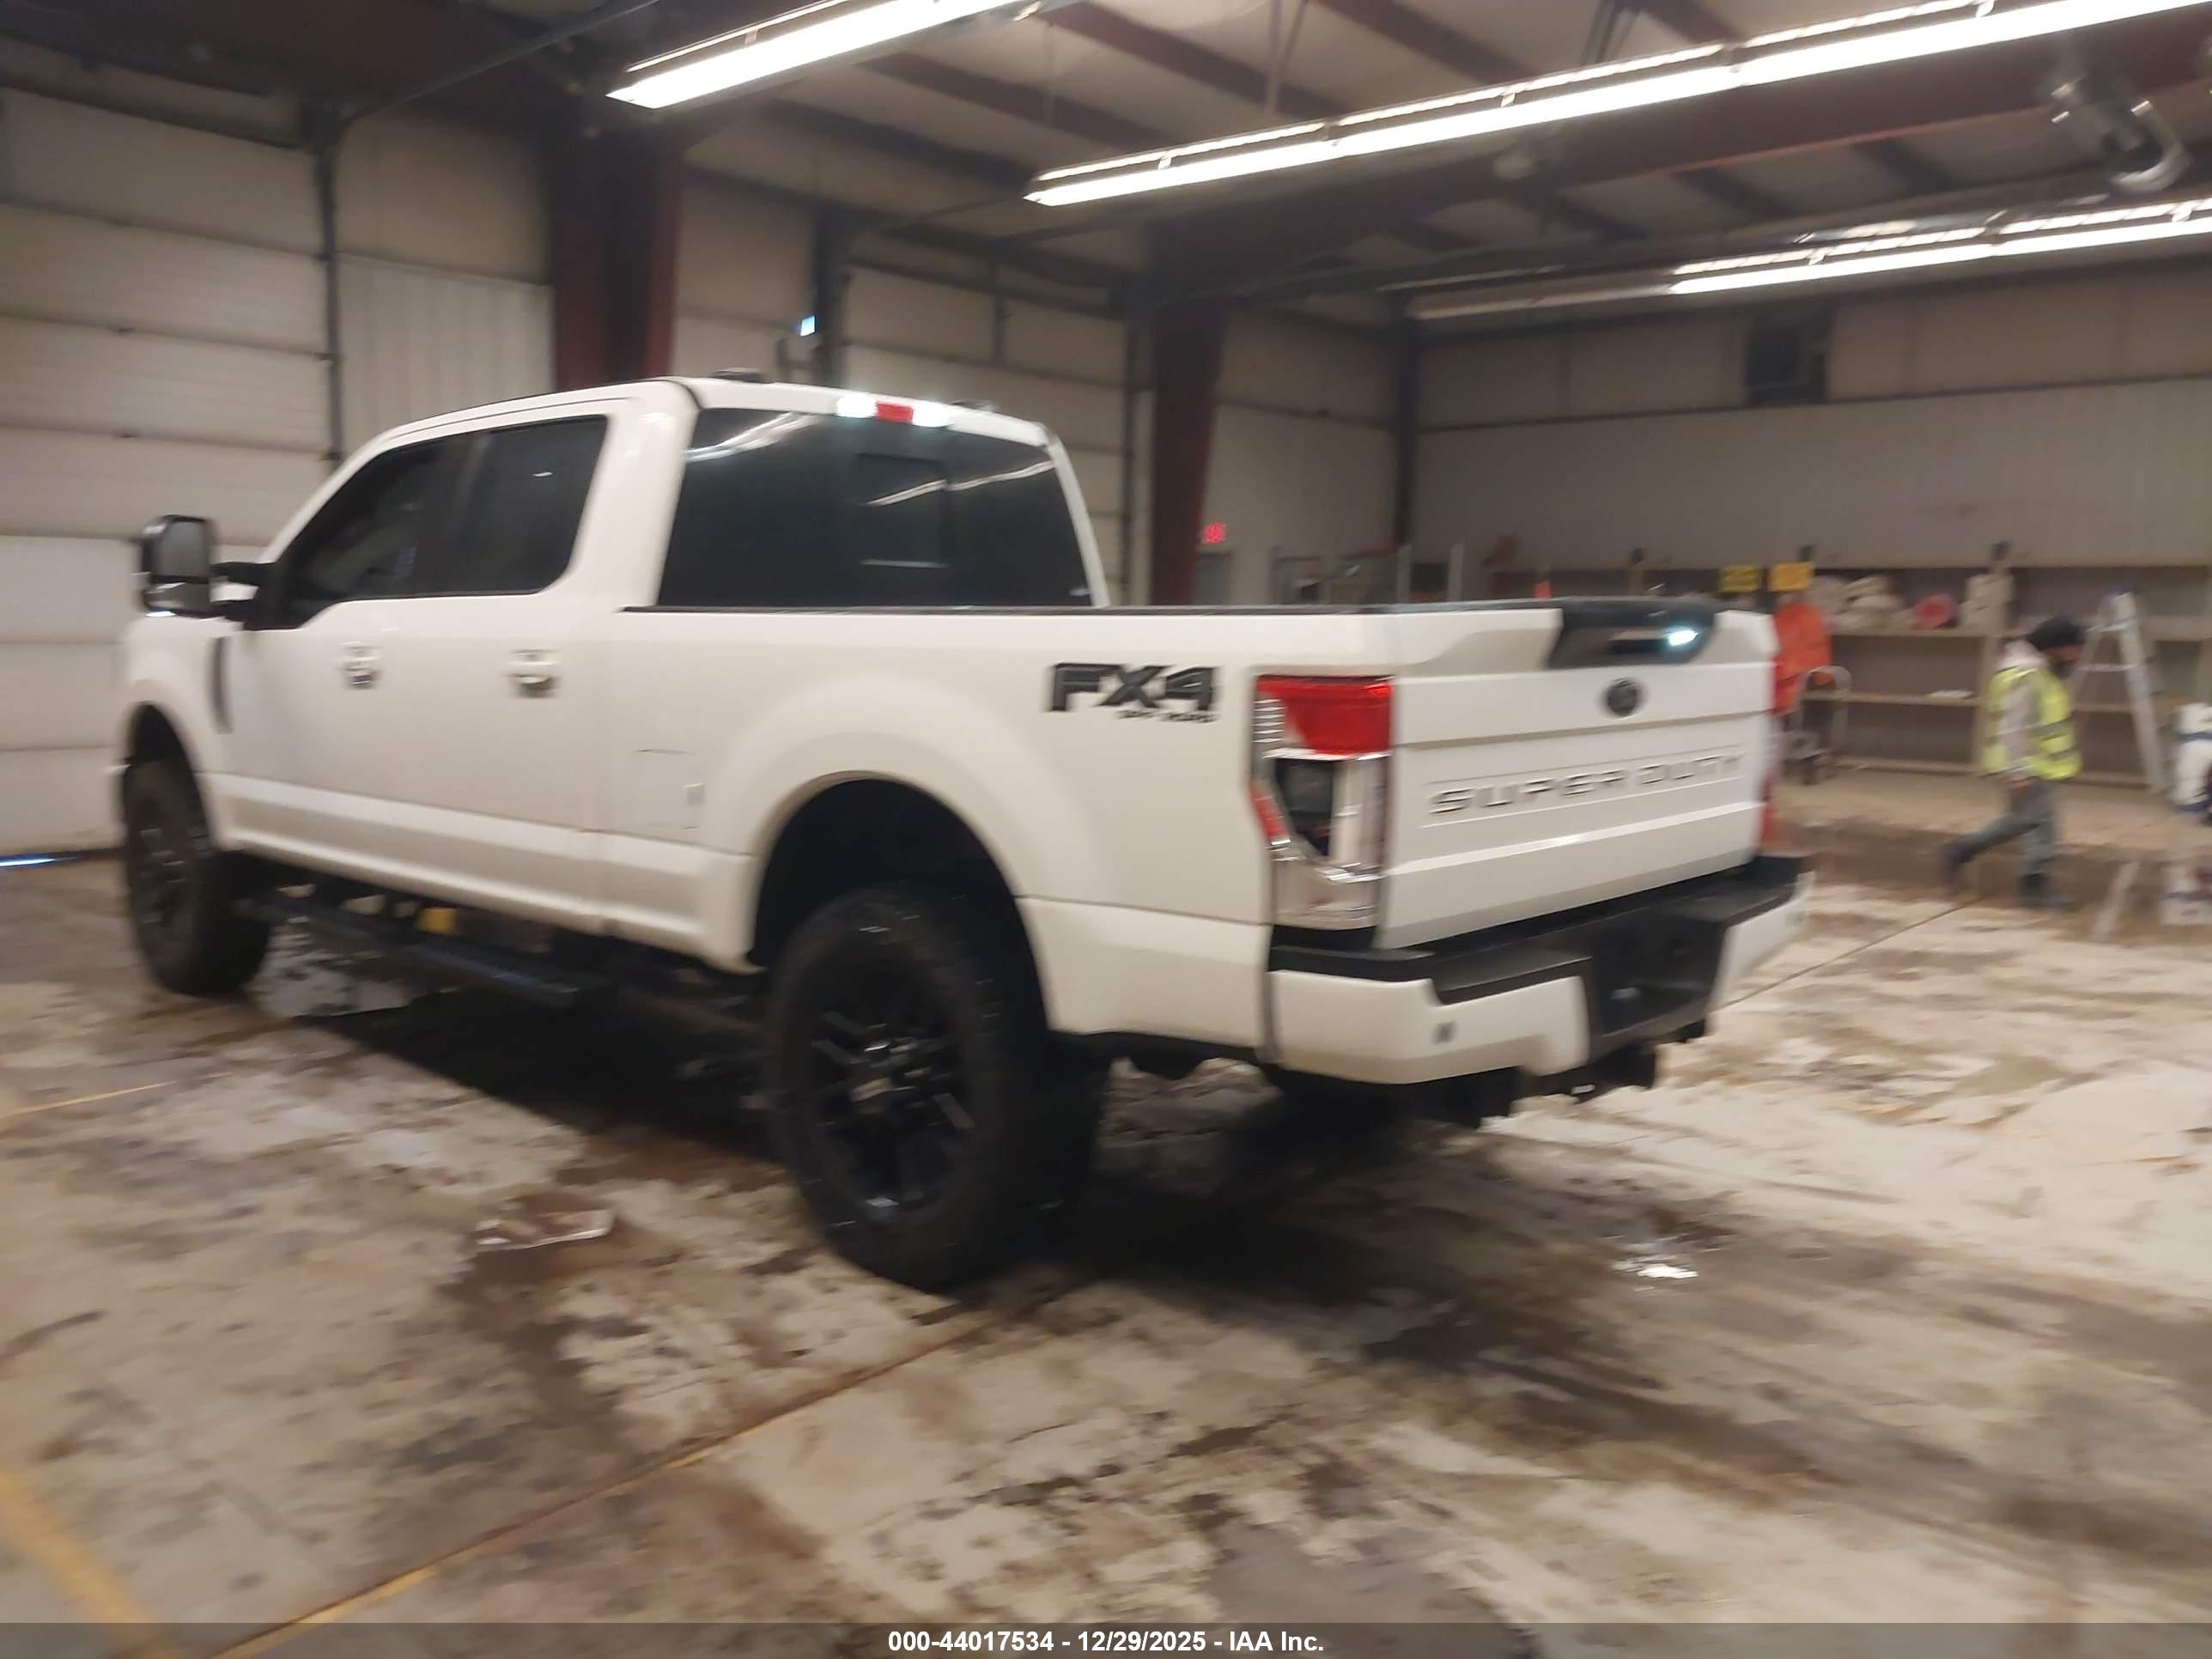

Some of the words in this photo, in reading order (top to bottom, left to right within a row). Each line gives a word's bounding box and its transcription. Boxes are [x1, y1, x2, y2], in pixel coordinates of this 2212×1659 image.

[1049, 663, 1214, 712] FX4
[1429, 769, 1626, 813] SUPER
[1636, 753, 1746, 785] DUTY
